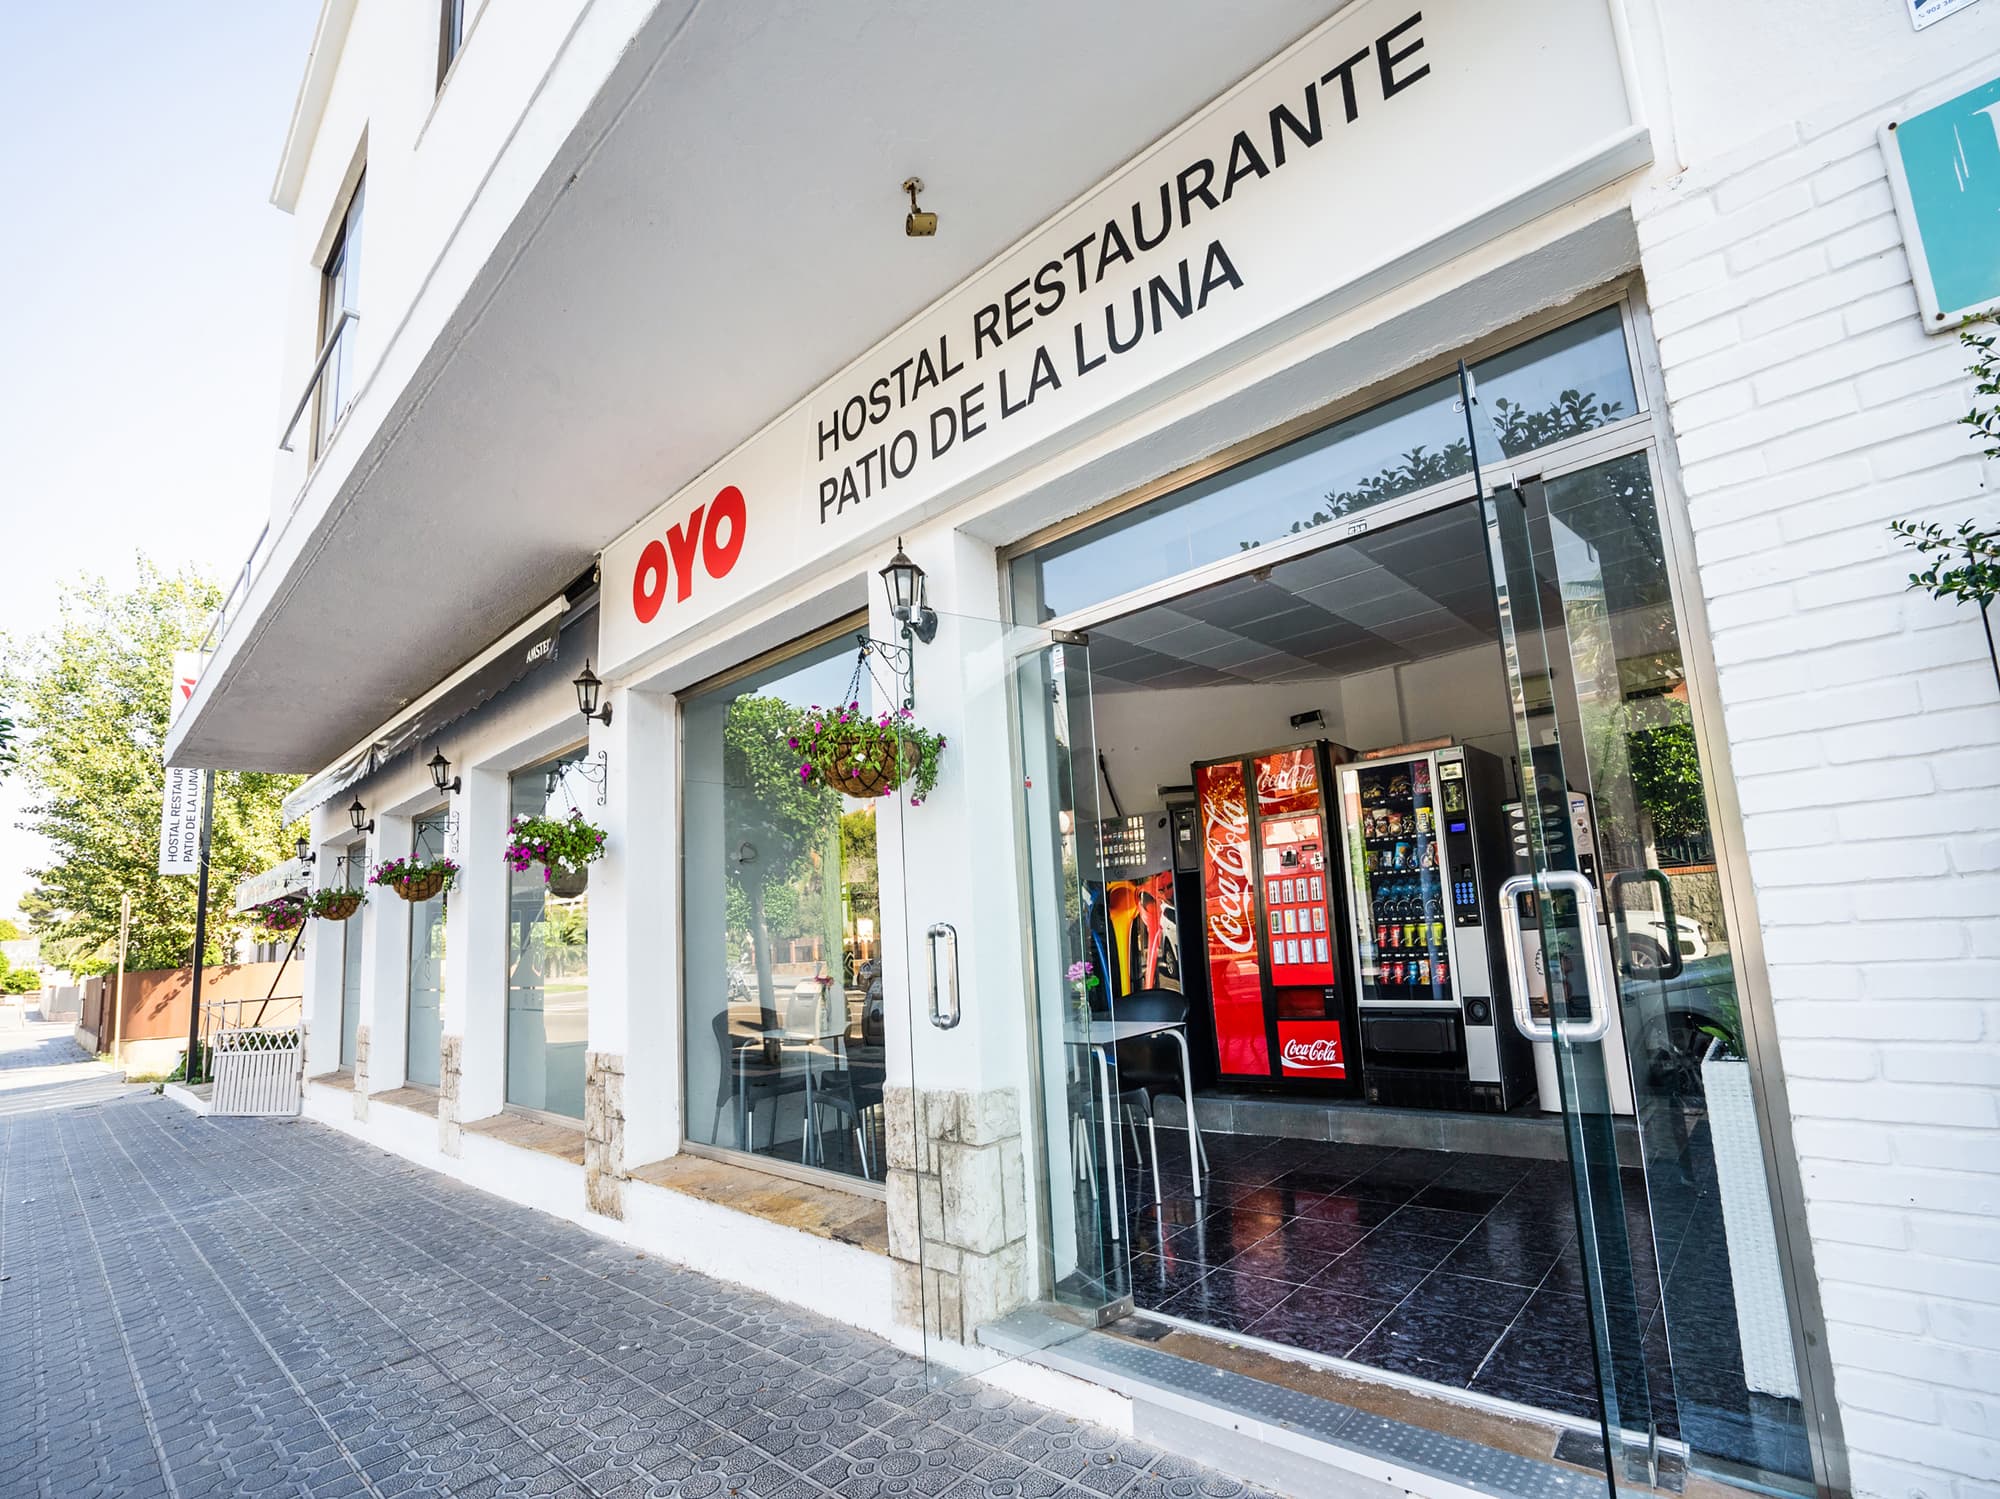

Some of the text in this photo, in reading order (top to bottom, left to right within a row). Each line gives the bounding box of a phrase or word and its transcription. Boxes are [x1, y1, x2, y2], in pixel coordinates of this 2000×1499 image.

[818, 11, 1430, 461] HOSTAL RESTAURANTE
[819, 239, 1244, 525] PATIO DE LA LUNA
[633, 485, 746, 623] OYO
[167, 768, 183, 862] HOSTAL RESTAUR
[183, 767, 198, 862] PATIO DE LA LUNA
[1204, 793, 1253, 952] Coca-Cola
[1284, 1039, 1337, 1061] Coca-Cola
